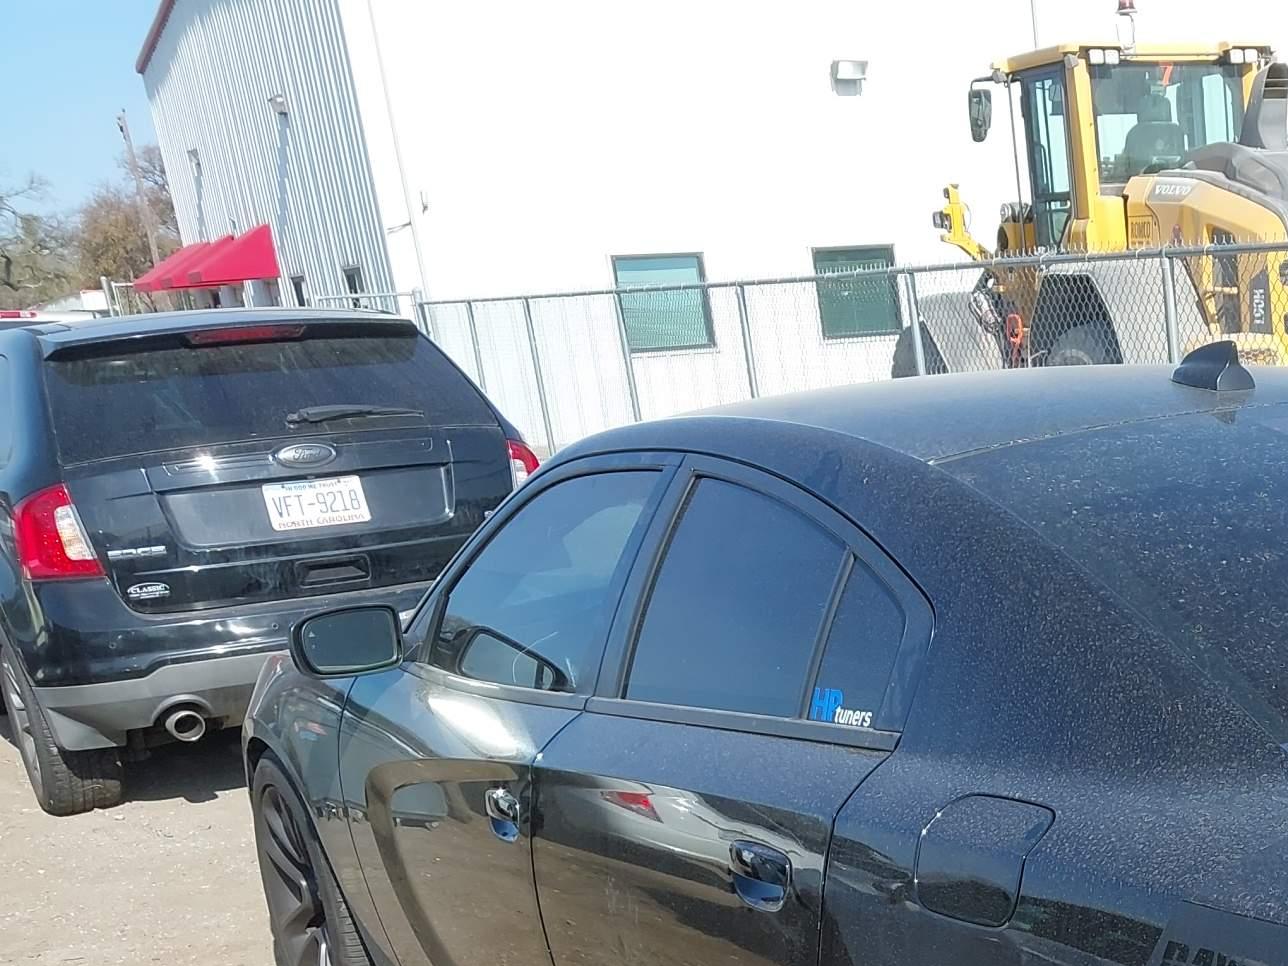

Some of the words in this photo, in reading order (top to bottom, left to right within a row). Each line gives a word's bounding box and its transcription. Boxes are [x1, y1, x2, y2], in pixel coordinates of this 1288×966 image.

[1160, 61, 1174, 86] 7
[1155, 184, 1192, 195] VOLVO
[272, 488, 361, 518] VFT-9218
[278, 519, 313, 529] NORTH
[129, 584, 167, 594] CLASSIC
